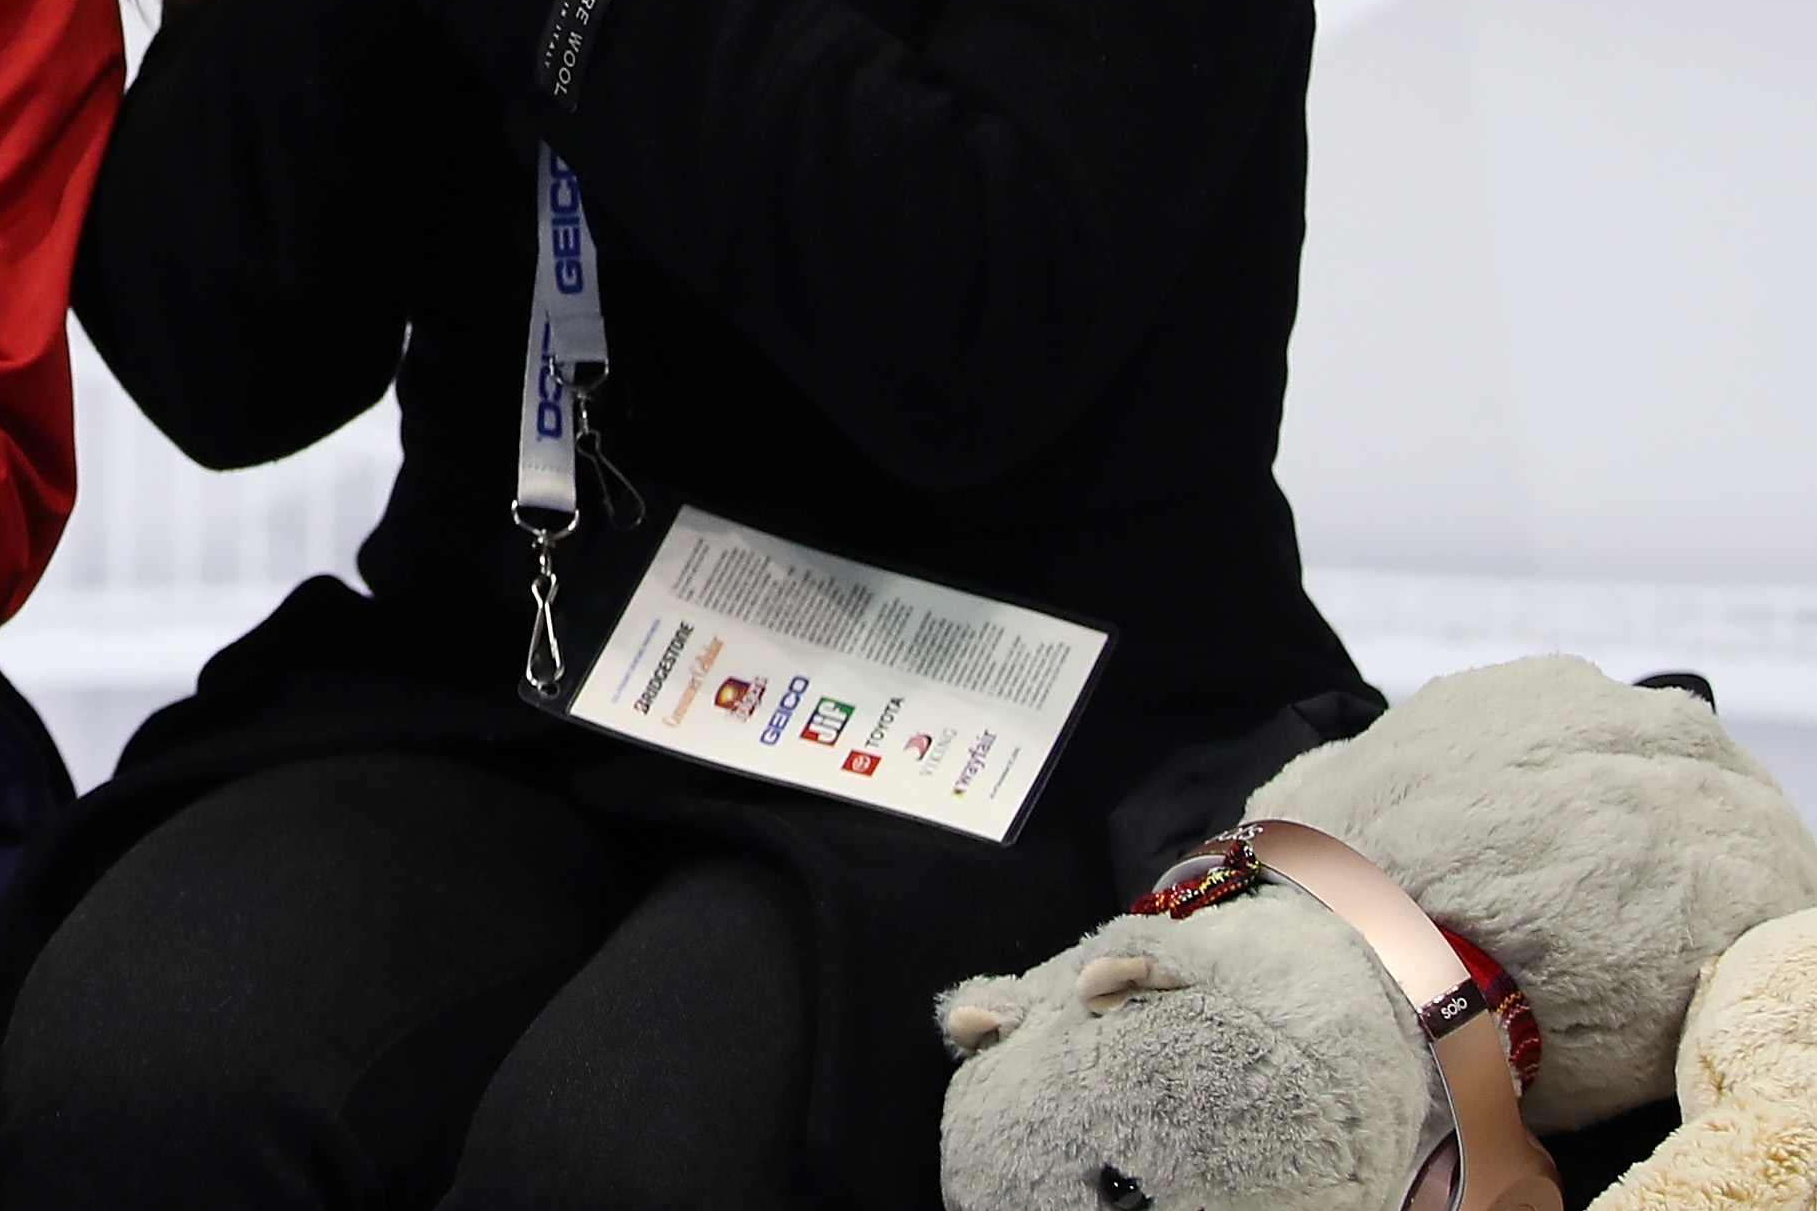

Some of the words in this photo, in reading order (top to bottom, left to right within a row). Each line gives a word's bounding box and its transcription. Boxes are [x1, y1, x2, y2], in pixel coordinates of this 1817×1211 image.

[553, 30, 583, 96] WOOL
[634, 620, 695, 716] BRIDGESTONE
[759, 675, 811, 746] GEICO
[864, 696, 906, 749] TOYOTA
[919, 726, 958, 778] VIKING
[1440, 997, 1469, 1020] solo
